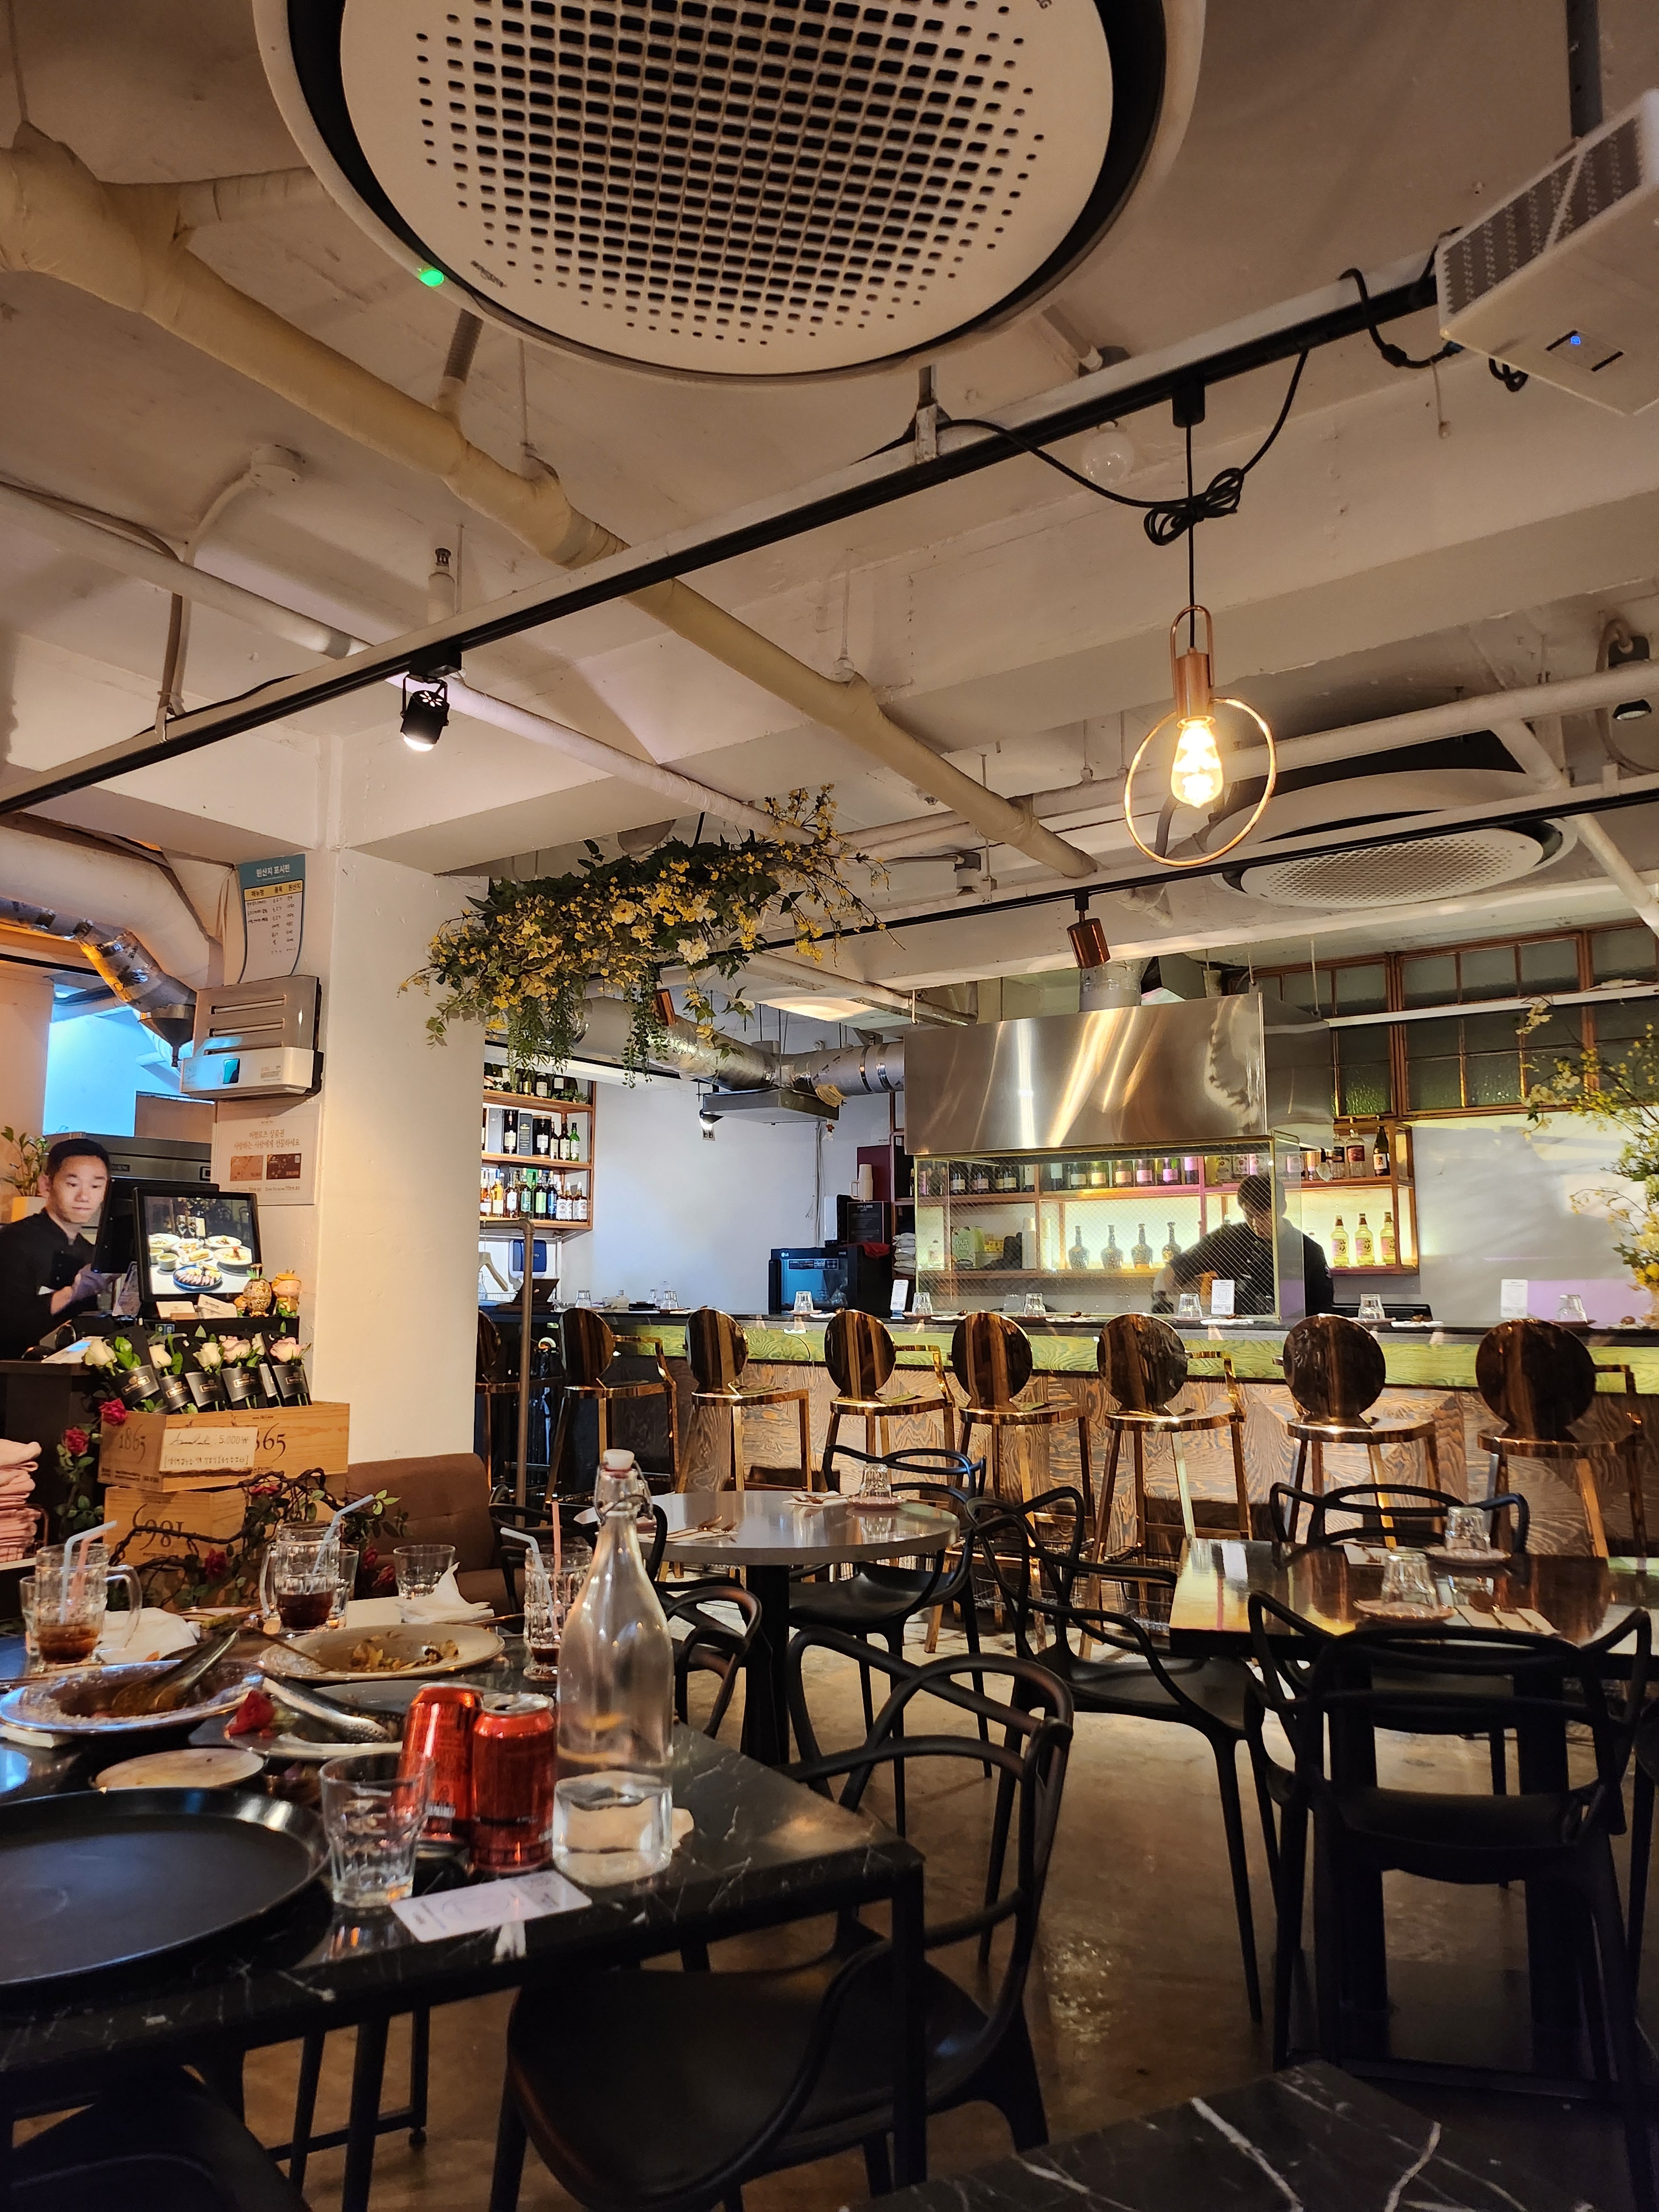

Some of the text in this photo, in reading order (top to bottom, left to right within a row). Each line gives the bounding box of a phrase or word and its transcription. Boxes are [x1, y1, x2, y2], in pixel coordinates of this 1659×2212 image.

[256, 864, 290, 878] 원산지 표시판
[288, 883, 301, 891] 원산지
[269, 1129, 285, 1139] 상품권
[234, 1138, 300, 1150] 사랑하는 사람에게 선물하세요
[119, 1424, 146, 1463] 1865
